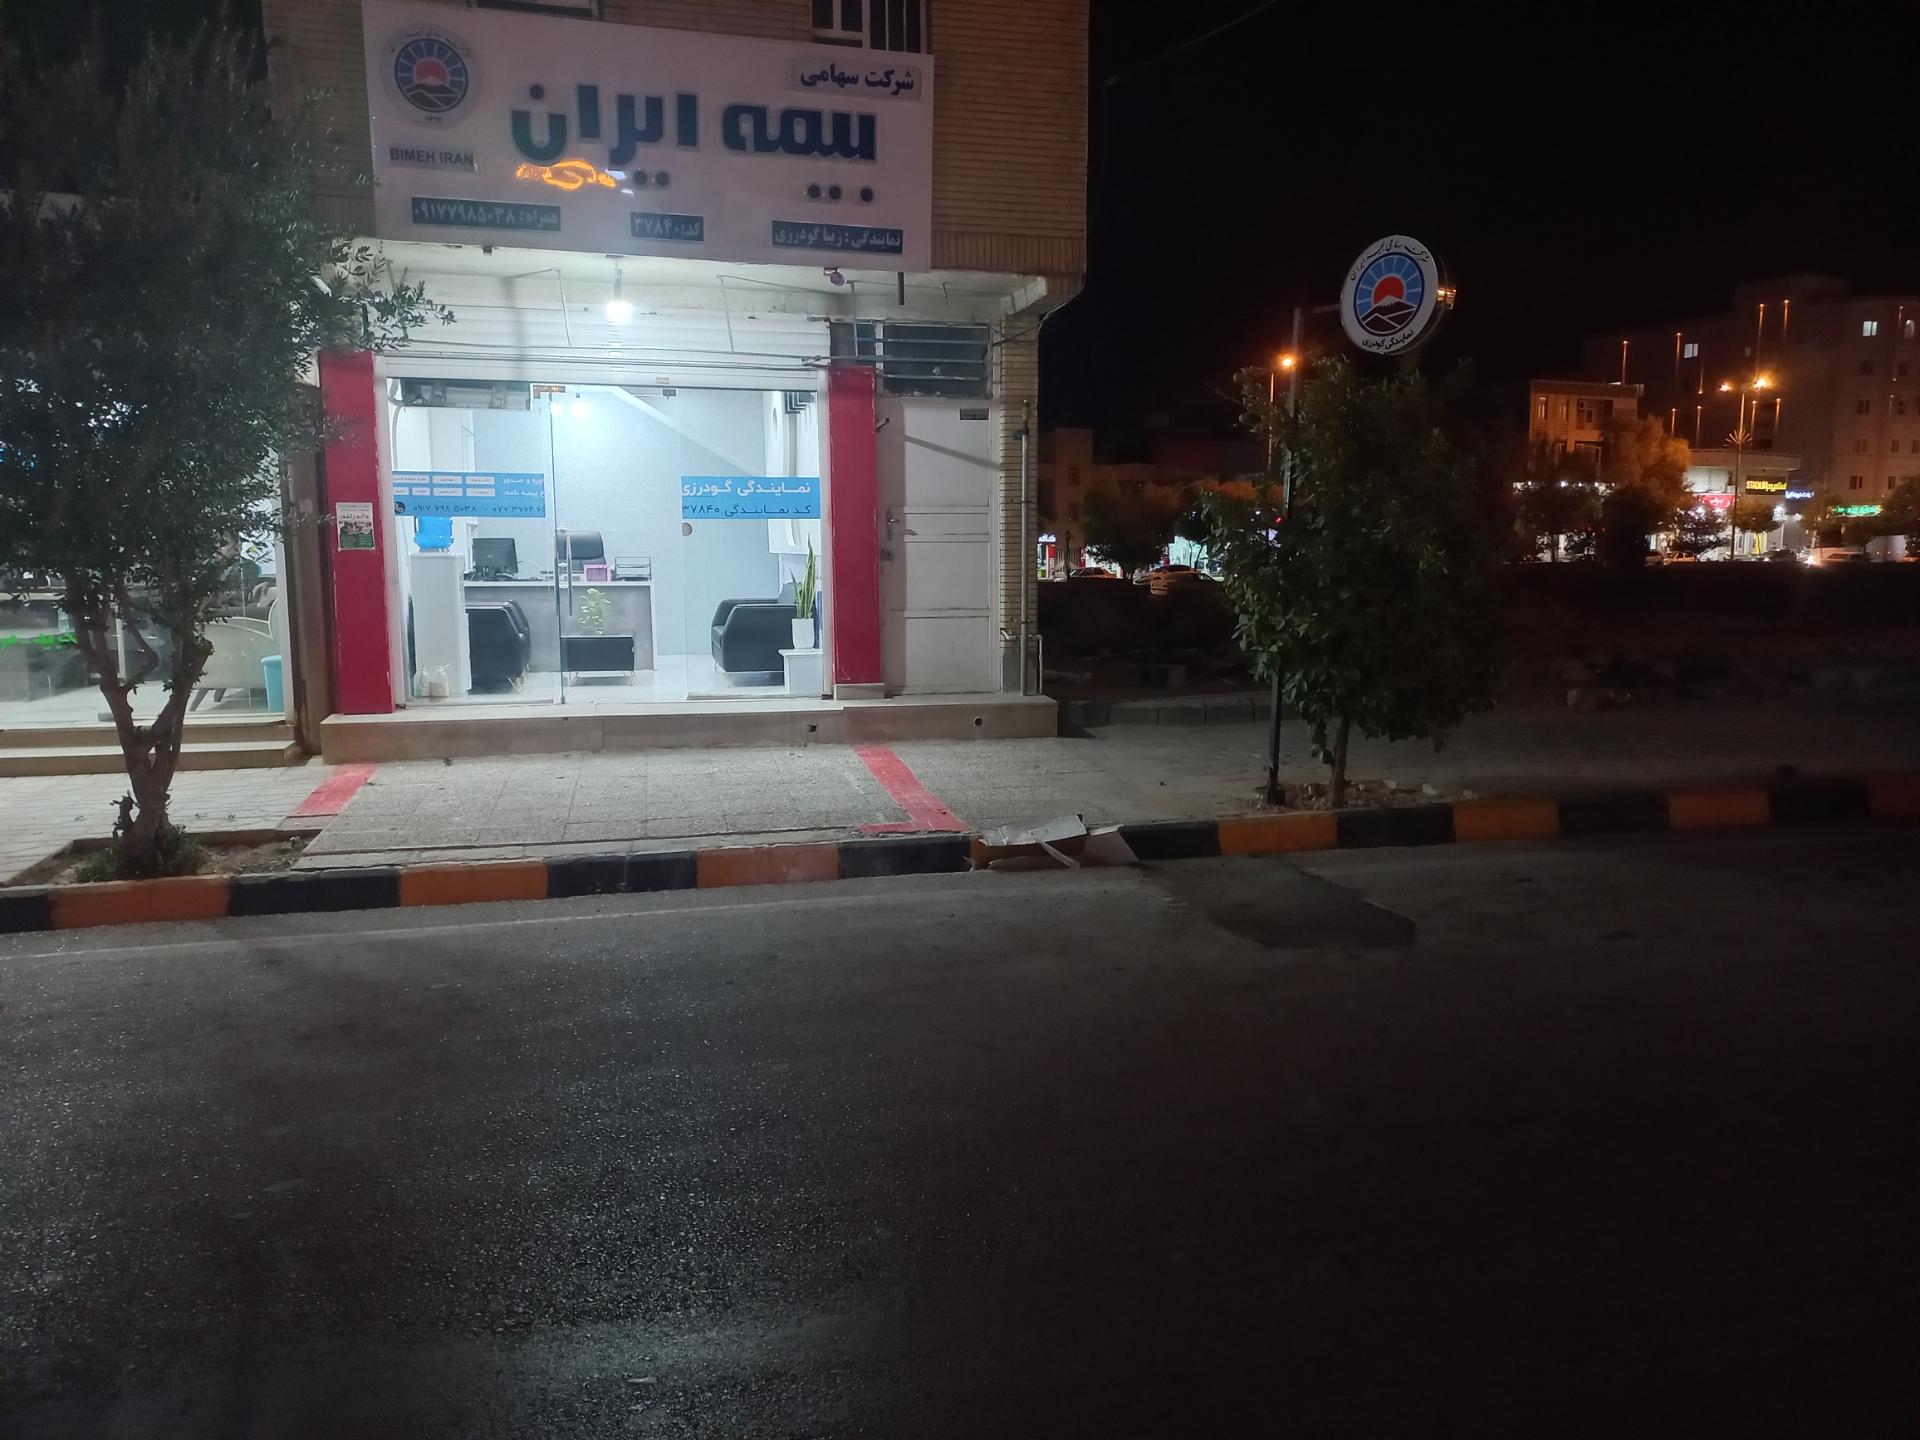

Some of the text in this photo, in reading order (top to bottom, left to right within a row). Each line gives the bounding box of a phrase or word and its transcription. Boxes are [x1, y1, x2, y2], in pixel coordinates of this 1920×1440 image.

[800, 62, 914, 96] شرکت سهامی
[511, 83, 876, 202] بیمه ایران
[390, 147, 474, 166] BIMEH IRAN
[414, 200, 515, 225] ۰۹۱۷۷۹۸۵۰۳۸
[774, 226, 820, 246] گودرزی
[823, 227, 843, 247] زیبا
[851, 230, 901, 250] نمایندگی
[682, 479, 811, 497] نمایندگی گودرزی
[682, 504, 811, 517] کد نمایندگی ۳۷۸۴۰
